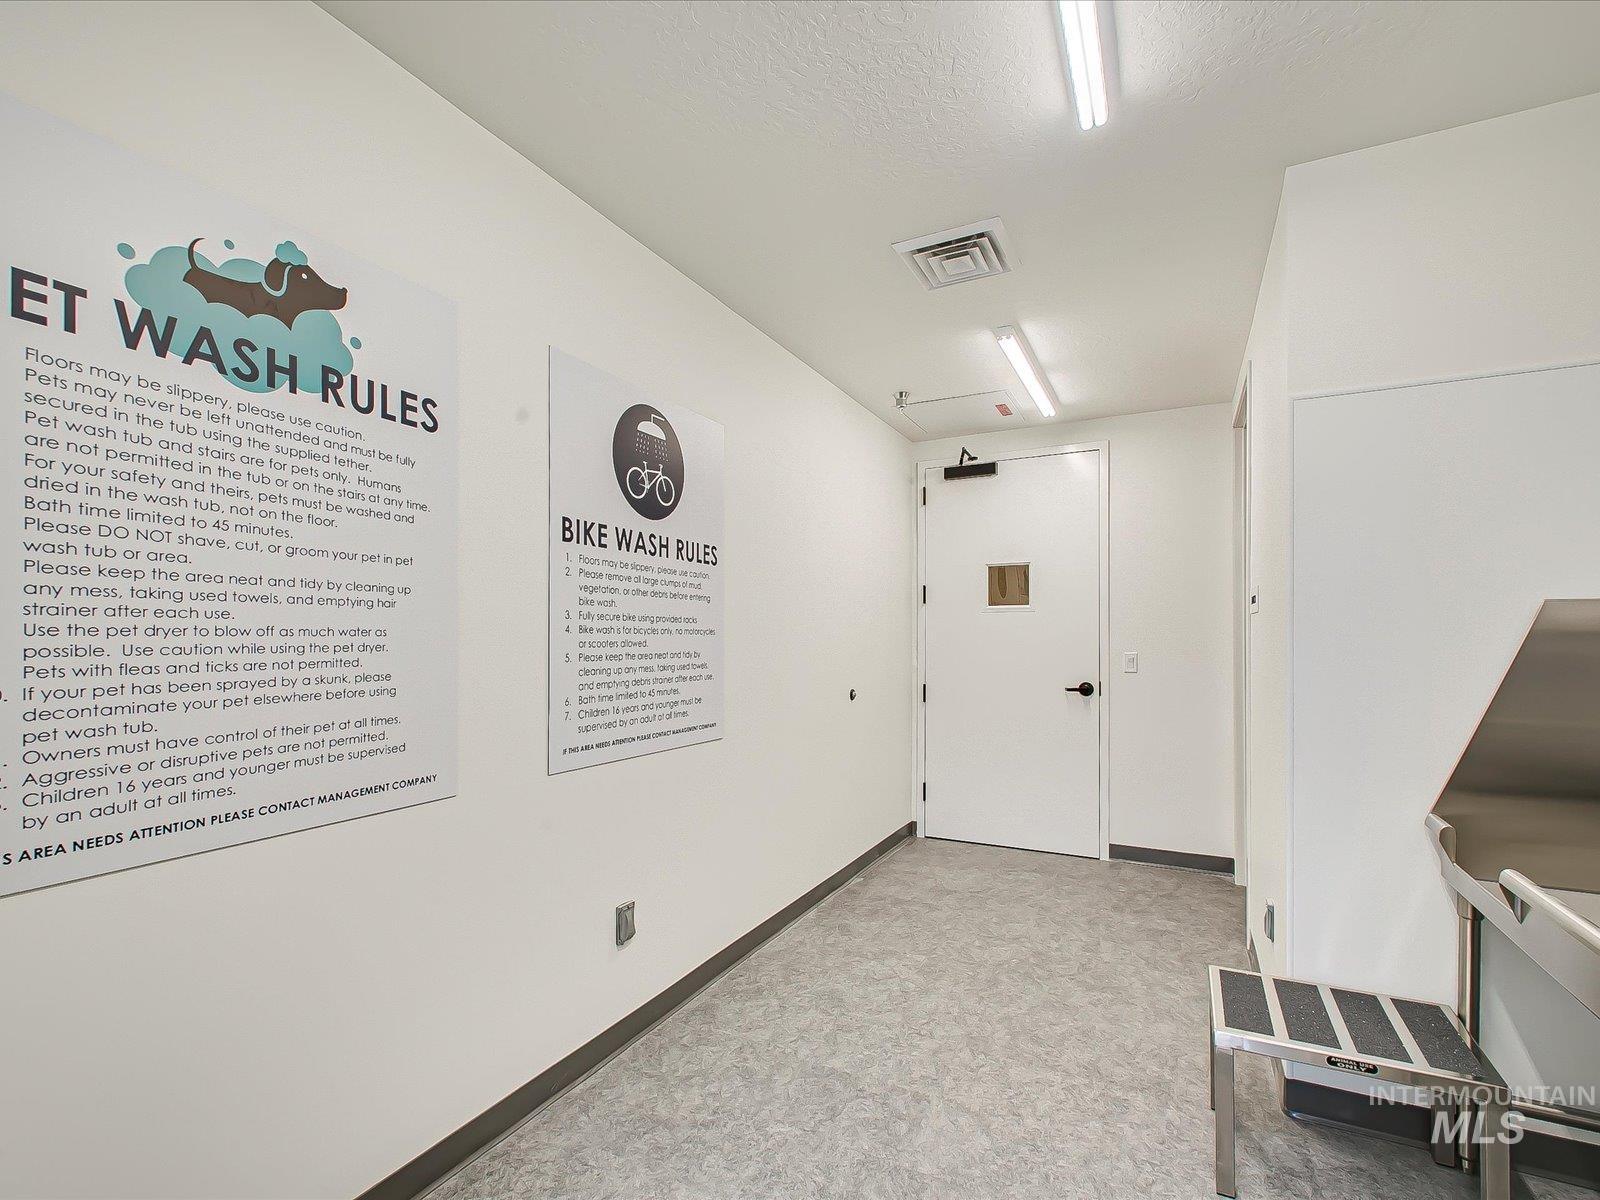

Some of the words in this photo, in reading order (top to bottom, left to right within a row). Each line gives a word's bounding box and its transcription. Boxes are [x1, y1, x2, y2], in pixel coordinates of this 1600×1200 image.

[10, 266, 87, 334] ET
[113, 298, 297, 394] WASH
[321, 364, 438, 433] RULES
[24, 346, 83, 373] Floors
[89, 365, 131, 386] may
[137, 374, 161, 391] be
[166, 383, 232, 409] slippery,
[236, 401, 285, 421] please
[288, 415, 311, 428] use
[314, 421, 365, 441] caution.
[24, 367, 67, 389] Pets
[74, 381, 117, 402] may
[123, 393, 175, 412] never
[179, 403, 202, 419] be
[206, 409, 231, 425] left
[235, 419, 319, 445] unattended
[323, 439, 347, 452] and
[350, 445, 375, 458] must
[378, 449, 393, 462] be
[395, 453, 416, 469] fully
[24, 409, 59, 429] Pet
[64, 420, 116, 440] wash
[122, 429, 152, 446] tub
[157, 439, 192, 454] and
[197, 445, 235, 462] stairs
[239, 454, 264, 467] are
[268, 457, 287, 471] for
[290, 464, 319, 478] pets
[321, 470, 350, 484] only.
[357, 475, 401, 493] Humans
[24, 452, 56, 470] For
[60, 461, 106, 477] your
[110, 469, 166, 489] safety
[171, 478, 204, 492] and
[209, 482, 253, 501] theirs,
[257, 492, 288, 505] pets
[291, 497, 322, 509] must
[325, 500, 342, 512] be
[345, 505, 391, 520] washed
[393, 513, 414, 524] and
[24, 495, 71, 514] Bath
[78, 501, 121, 519] time
[126, 507, 185, 526] limited
[190, 515, 207, 529] to
[211, 518, 229, 531] 45
[234, 522, 293, 538] minutes.
[561, 516, 608, 549] BIKE
[615, 526, 669, 558] WASH
[676, 538, 718, 566] RULES
[23, 558, 91, 576] Please
[97, 563, 145, 581] keep
[151, 567, 179, 581] the
[184, 572, 223, 584] area
[228, 574, 263, 586] neat
[267, 576, 295, 587] and
[299, 577, 323, 591] tidy
[326, 579, 342, 592] by
[344, 580, 394, 596] cleaning
[397, 586, 411, 596] up
[564, 566, 572, 576] 2.
[578, 568, 603, 579] Please
[604, 573, 632, 582] remove
[633, 574, 641, 583] all
[641, 575, 658, 586] large
[659, 578, 680, 589] clumps
[565, 552, 572, 562] 1.
[578, 554, 600, 565] Floors
[601, 559, 617, 570] may
[619, 560, 628, 569] be
[657, 565, 677, 575] please
[564, 610, 572, 619] 3.
[578, 611, 594, 622] Fully
[621, 613, 636, 621] bike
[637, 614, 654, 624] using
[655, 615, 681, 624] provided
[578, 596, 594, 606] bike
[23, 643, 110, 661] possible.
[122, 643, 153, 656] Use
[159, 642, 222, 656] caution
[227, 642, 266, 654] while
[269, 642, 305, 656] using
[308, 642, 329, 653] the
[333, 642, 354, 655] pet
[356, 642, 388, 654] dryer.
[564, 653, 572, 662] 5.
[578, 653, 603, 662] Please
[604, 652, 623, 662] keep
[624, 652, 636, 660] the
[653, 651, 668, 659] neat
[669, 650, 681, 658] and
[587, 639, 618, 648] scooters
[22, 686, 34, 700] If
[40, 687, 86, 703] your
[92, 682, 125, 700] pet
[131, 682, 161, 695] has
[167, 680, 211, 693] been
[216, 676, 276, 692] sprayed
[281, 675, 297, 689] by
[301, 676, 310, 685] a
[314, 673, 350, 685] skunk,
[354, 672, 392, 685] please
[564, 697, 571, 706] 6.
[578, 694, 595, 705] Bath
[597, 693, 613, 703] time
[614, 690, 638, 701] limited
[639, 690, 646, 698] to
[647, 688, 655, 697] 45
[21, 785, 108, 807] Children
[117, 779, 135, 793] 16
[141, 774, 187, 793] years
[192, 766, 224, 782] and
[229, 760, 290, 780] younger
[293, 753, 324, 768] must
[327, 752, 344, 763] be
[347, 741, 406, 760] supervised
[17, 843, 67, 862] AREA
[72, 831, 123, 852] NEEDS
[128, 816, 205, 841] ATTENTION
[210, 807, 254, 825] PLEASE
[257, 796, 315, 816] CONTACT
[316, 782, 390, 804] MANAGEMENT
[391, 773, 437, 790] COMPANY
[1336, 1062, 1366, 1072] ONLY
